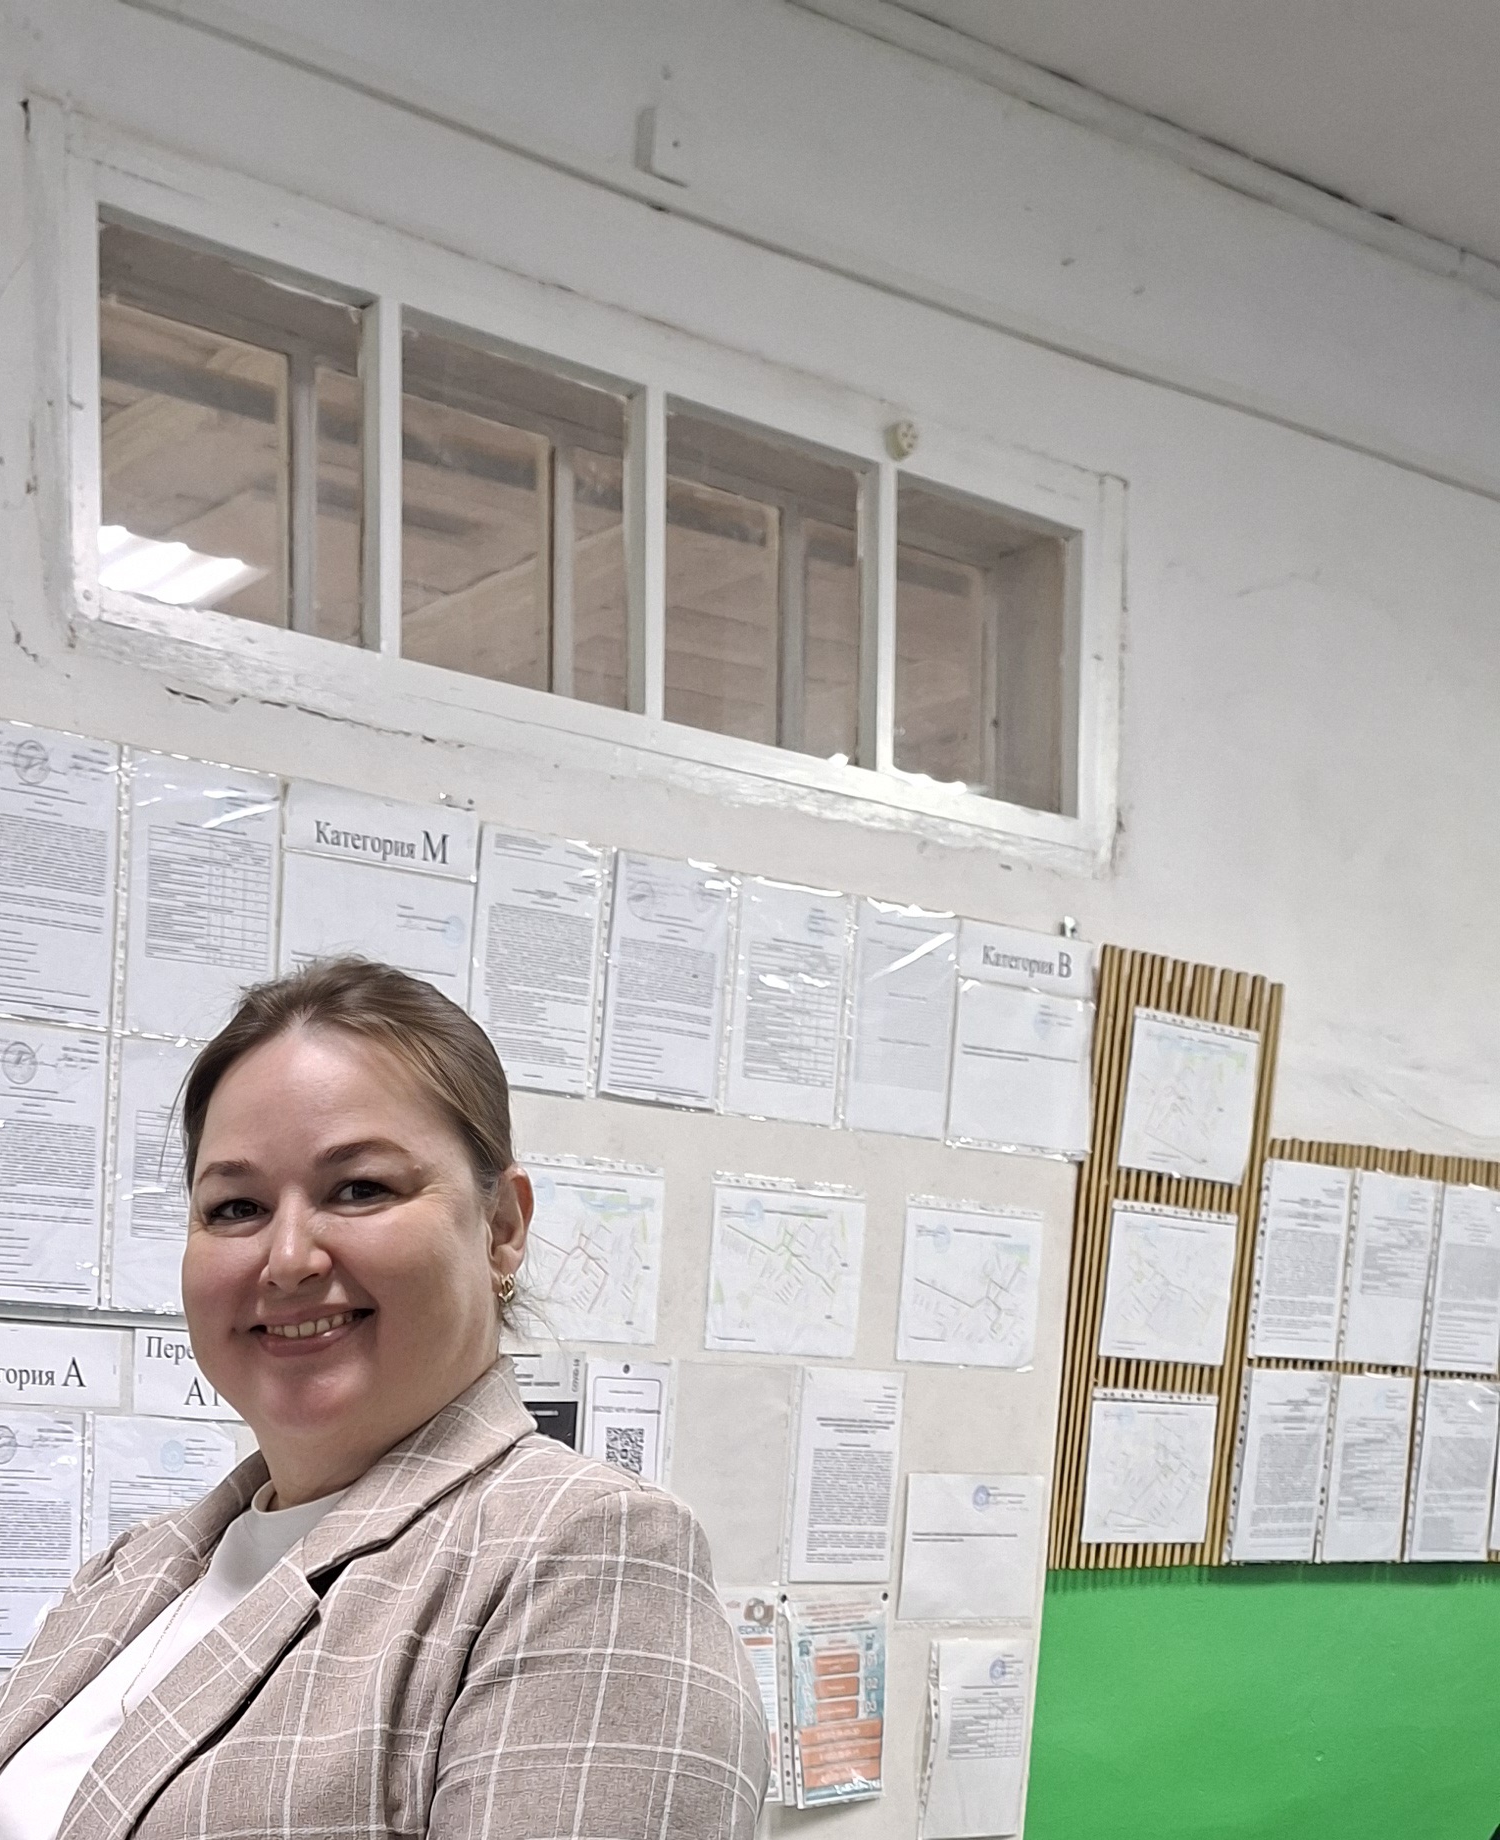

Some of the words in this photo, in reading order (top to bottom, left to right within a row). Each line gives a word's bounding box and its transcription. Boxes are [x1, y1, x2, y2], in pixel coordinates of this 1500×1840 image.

[314, 819, 416, 862] Категория
[422, 830, 450, 865] М
[1058, 951, 1073, 979] В
[61, 1356, 87, 1389] А
